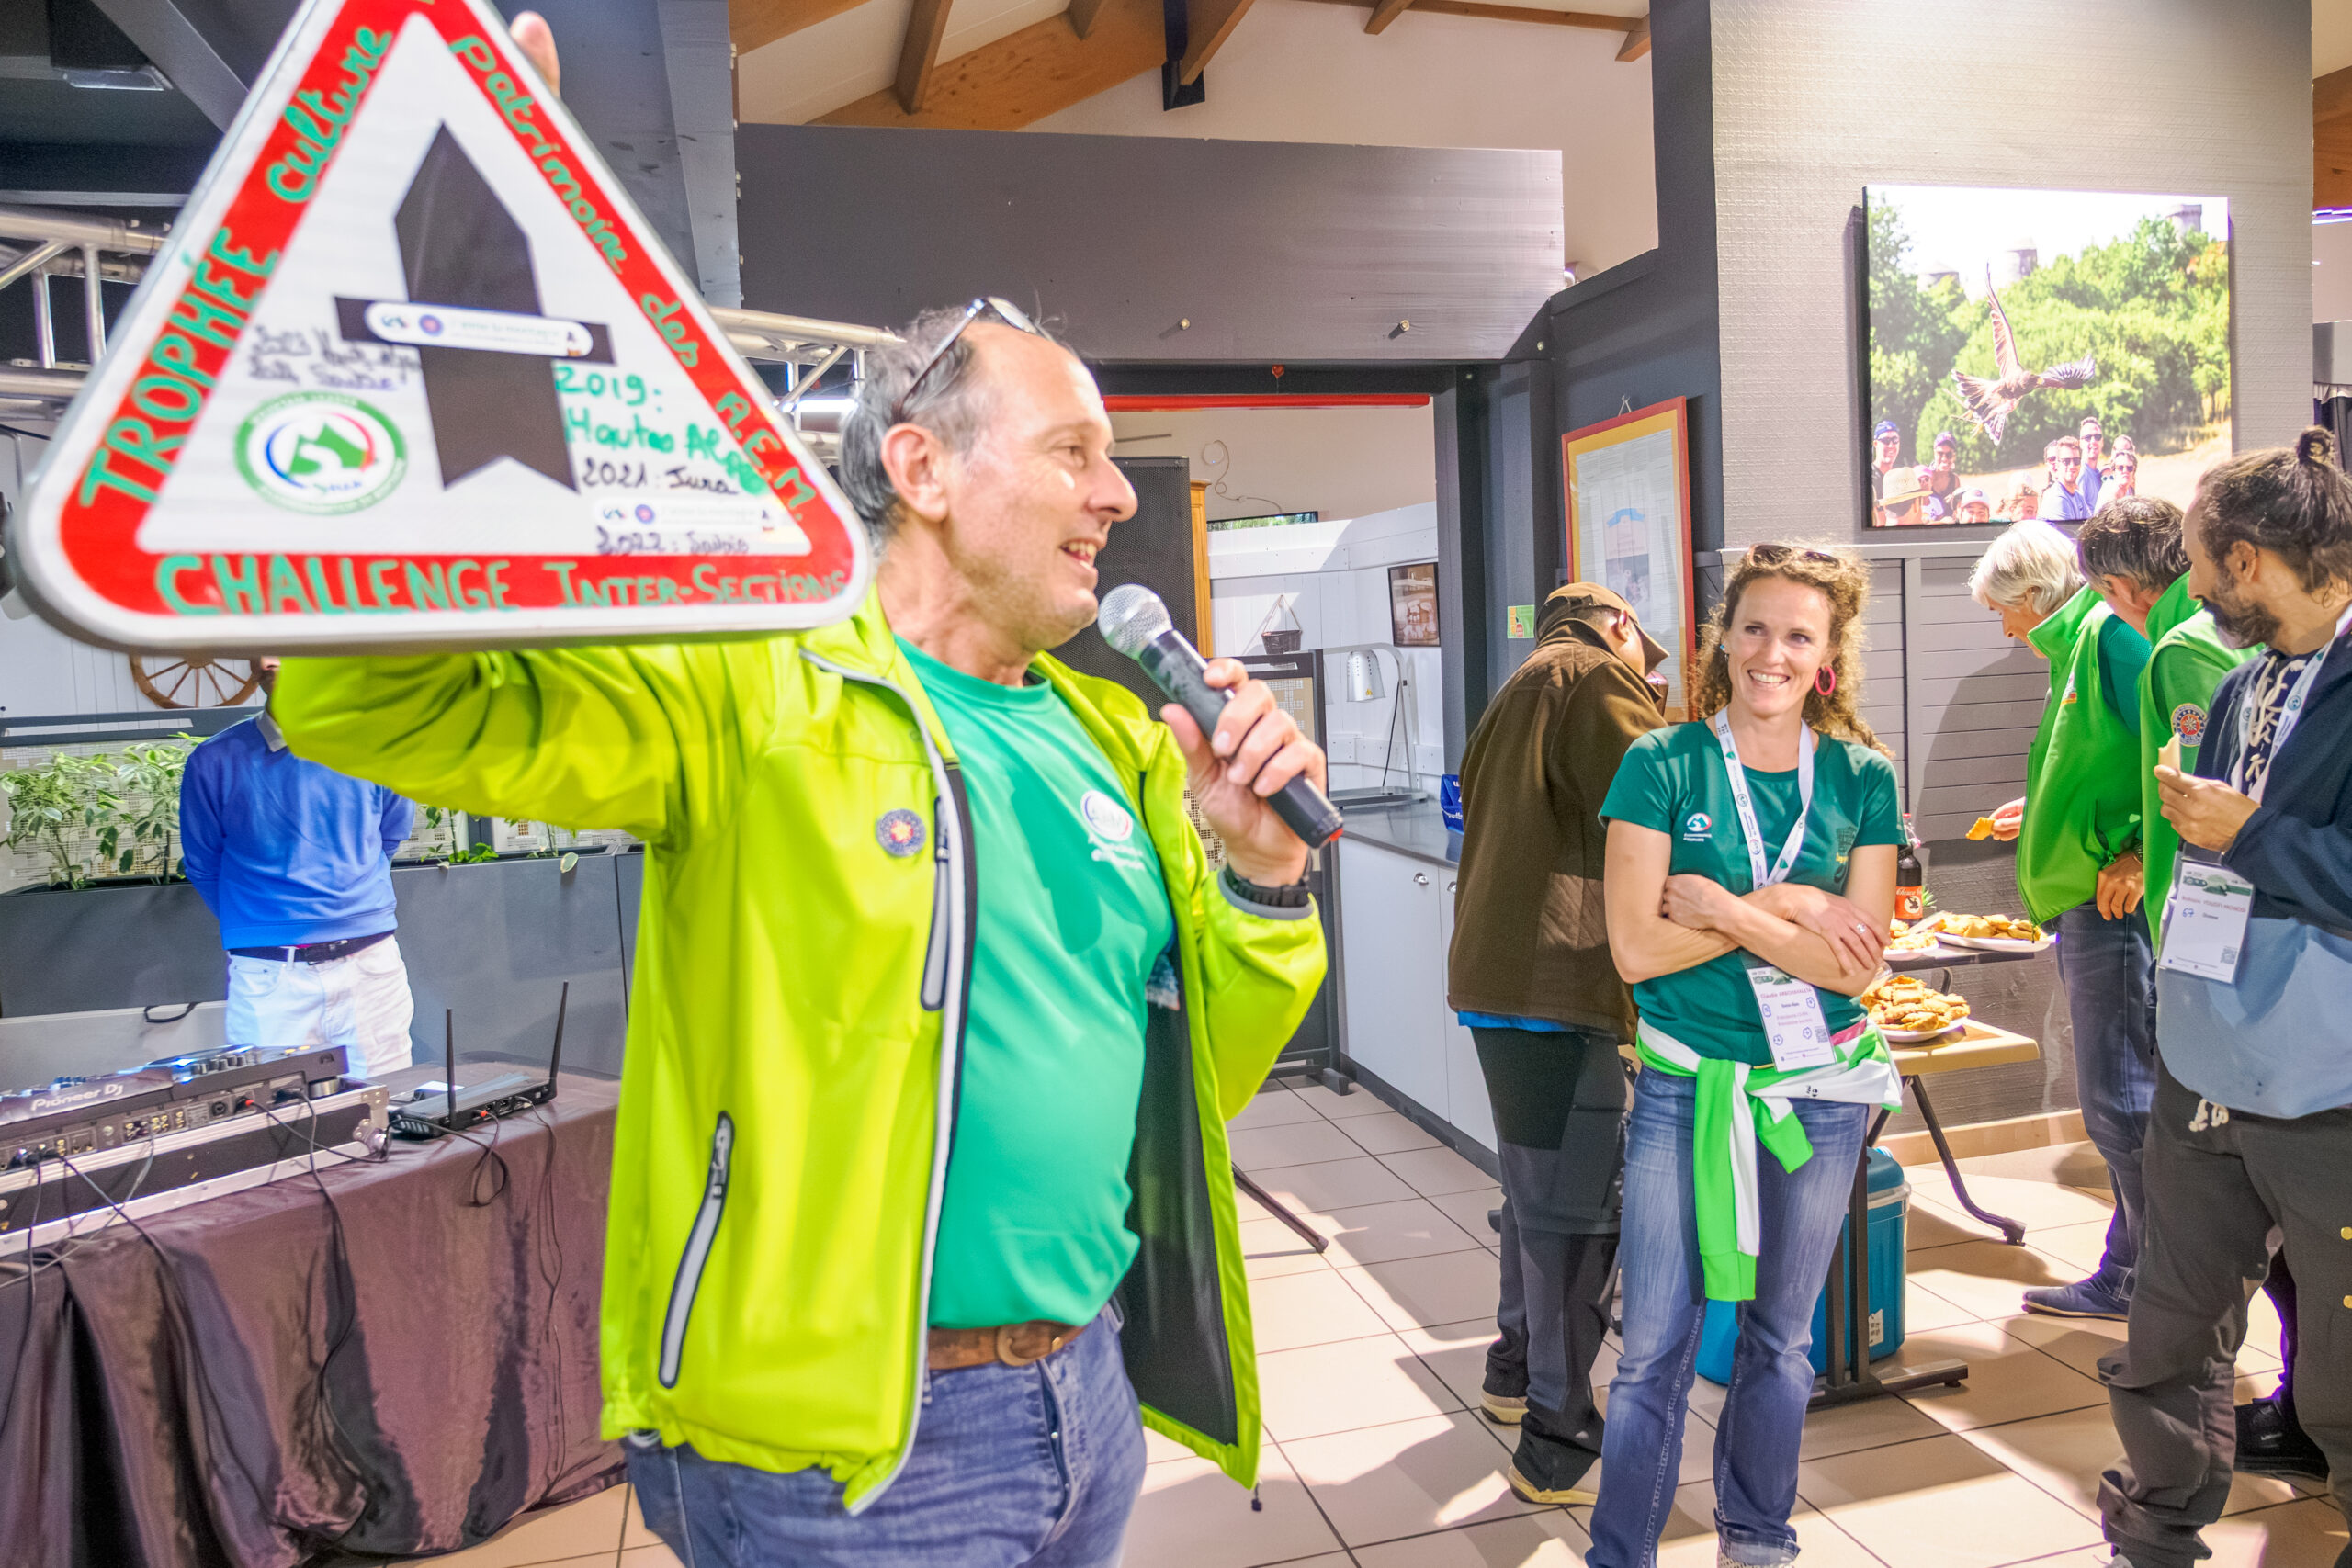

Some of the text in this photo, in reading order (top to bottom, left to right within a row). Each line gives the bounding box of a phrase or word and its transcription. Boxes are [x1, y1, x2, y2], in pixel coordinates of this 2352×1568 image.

[644, 293, 699, 367] des
[665, 465, 739, 495] Jura
[156, 555, 518, 615] CHALLENGE
[31, 1088, 101, 1111] Pioneer
